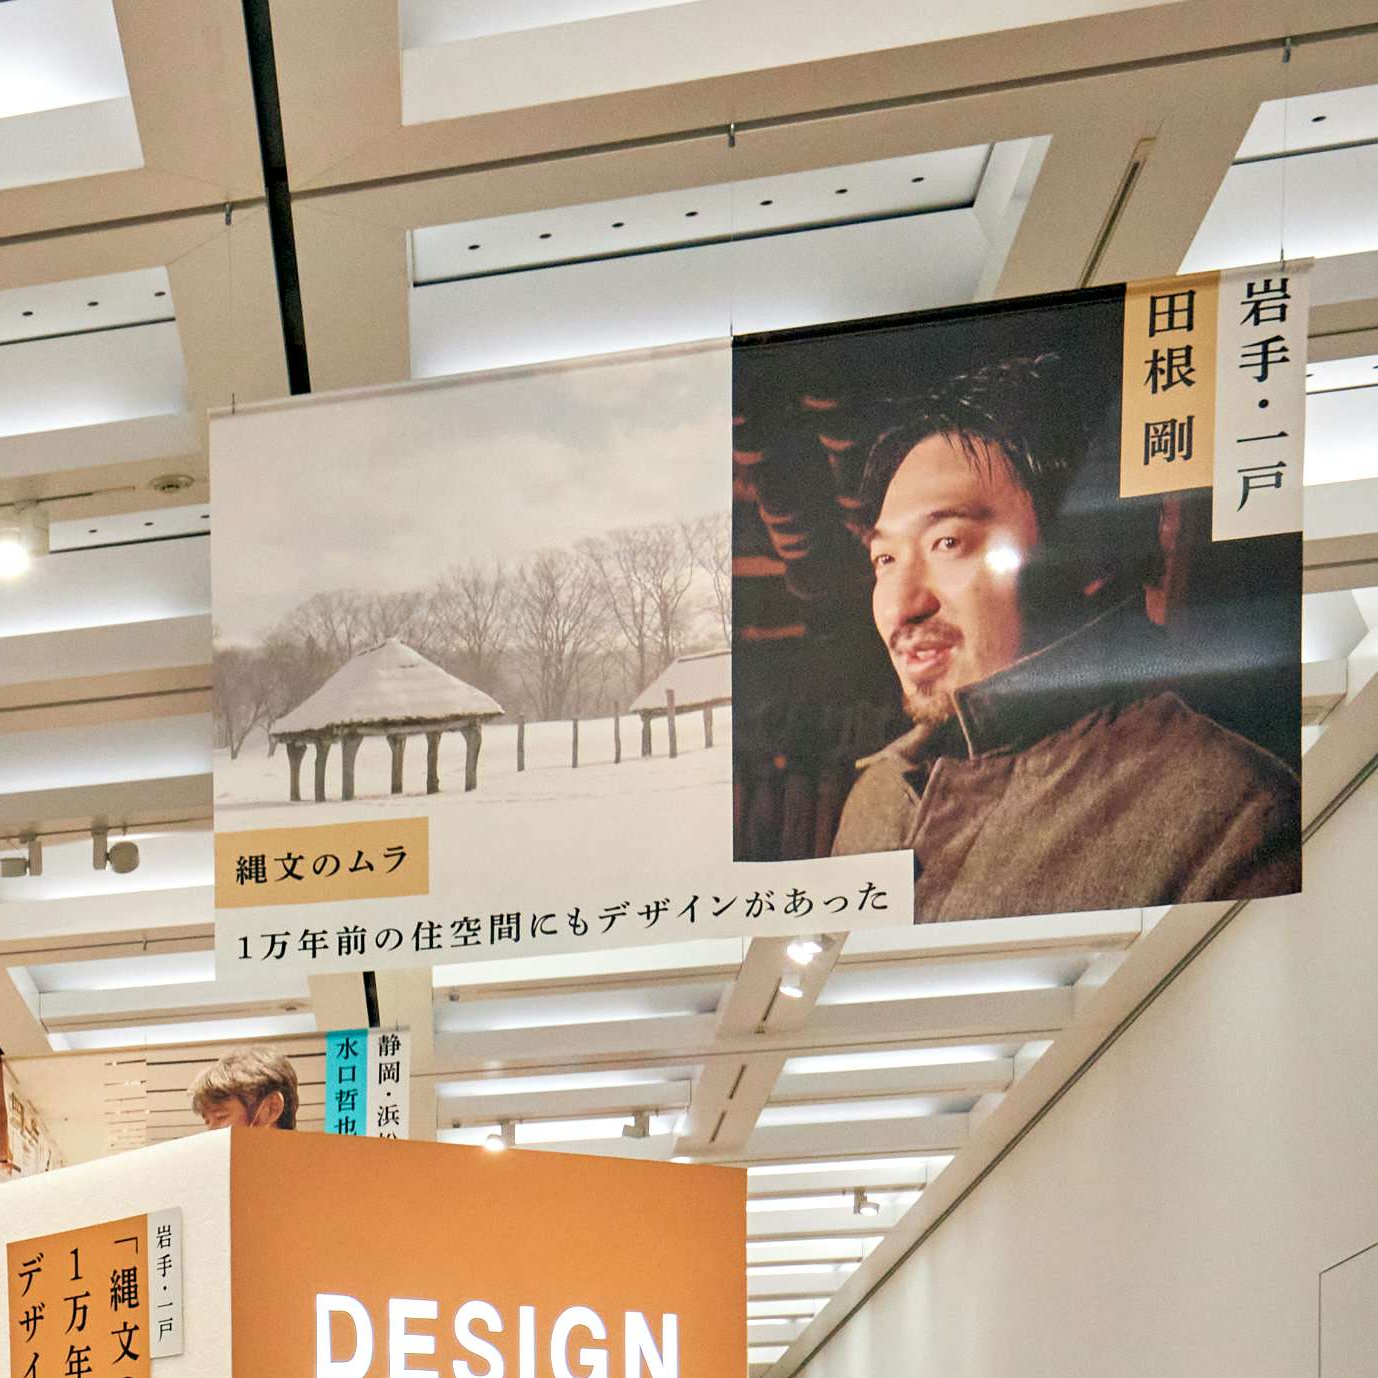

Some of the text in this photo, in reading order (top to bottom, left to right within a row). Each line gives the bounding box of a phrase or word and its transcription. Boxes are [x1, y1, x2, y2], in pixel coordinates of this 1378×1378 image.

[1144, 289, 1196, 466] 田根 剛
[1237, 278, 1291, 512] 岩手・一戸
[234, 841, 409, 887] 縄文のムラ
[237, 875, 890, 964] 1万年前の住空間にもデザインがあった
[334, 1037, 358, 1135] 水口哲也
[378, 1033, 401, 1139] 静岡・浜
[155, 1224, 175, 1343] 岩手・一戸
